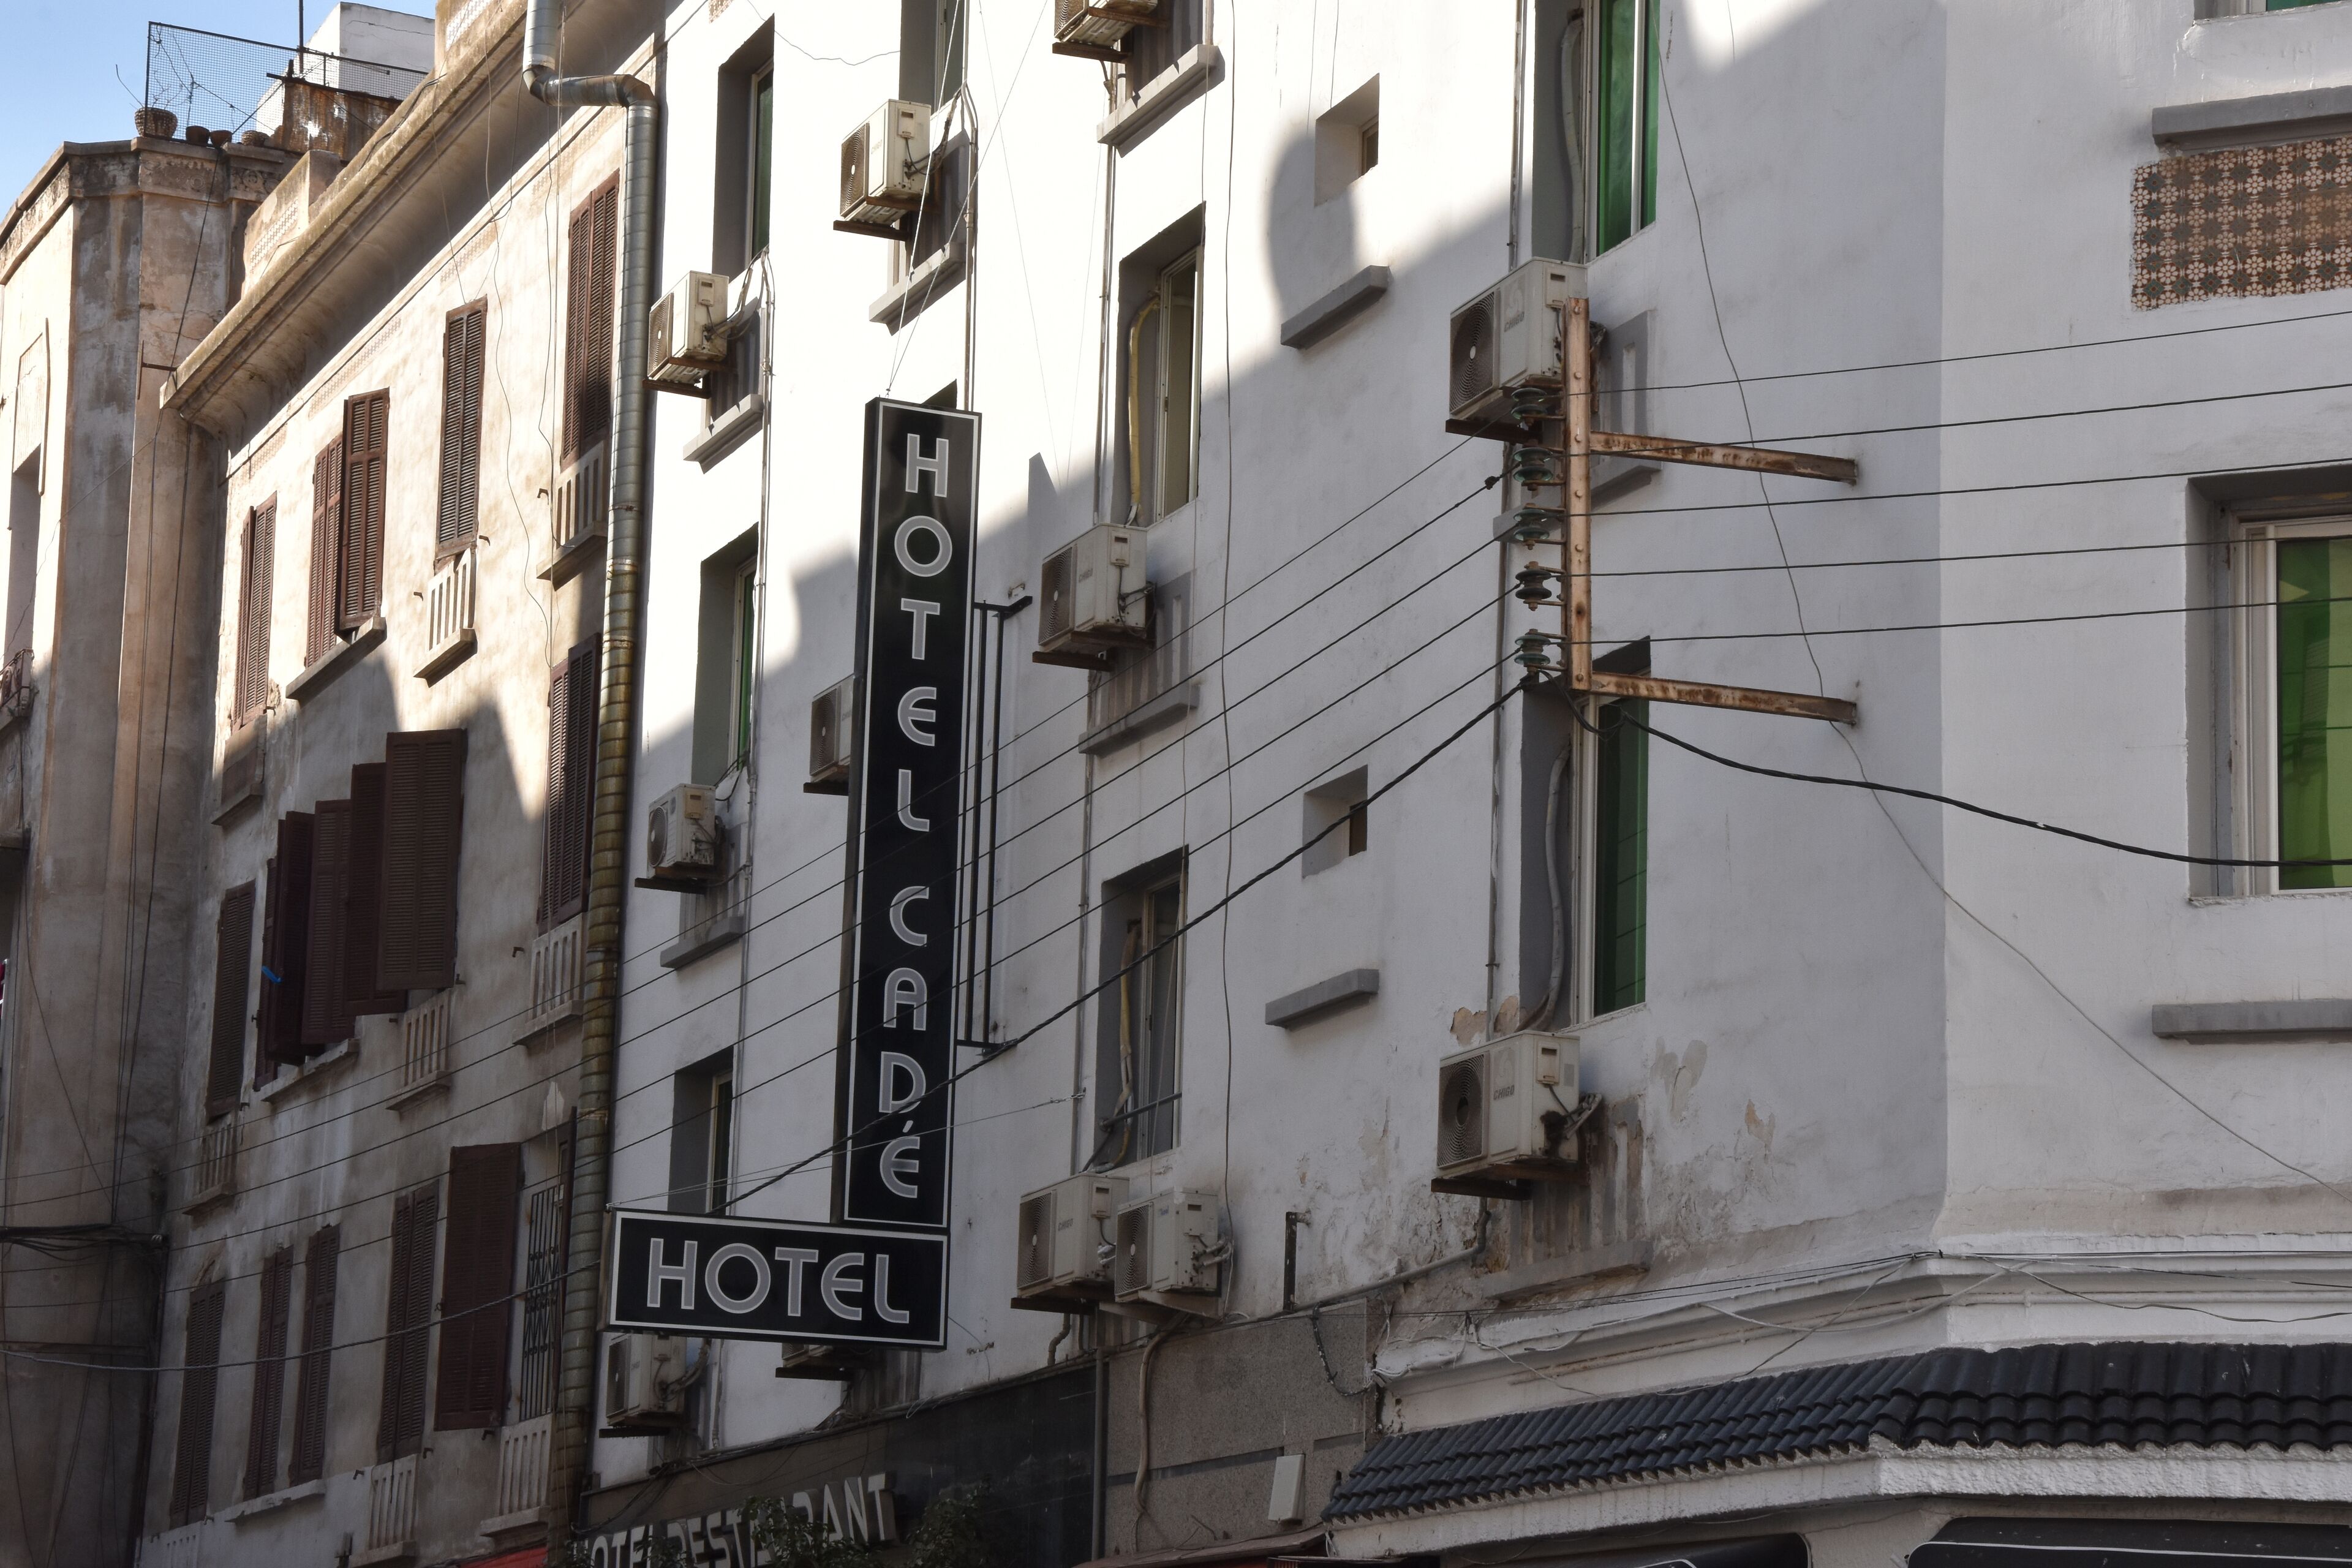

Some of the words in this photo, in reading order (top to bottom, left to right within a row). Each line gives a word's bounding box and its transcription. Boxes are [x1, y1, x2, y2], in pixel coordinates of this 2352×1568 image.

[1504, 311, 1525, 333] CHIGO
[894, 433, 953, 832] HOTEL
[878, 885, 930, 1199] CADÉ
[1493, 1084, 1515, 1100] CHIGO
[646, 1237, 910, 1324] HOTEL
[573, 1523, 654, 1568] OTE
[666, 1472, 887, 1568] ESTAANT
